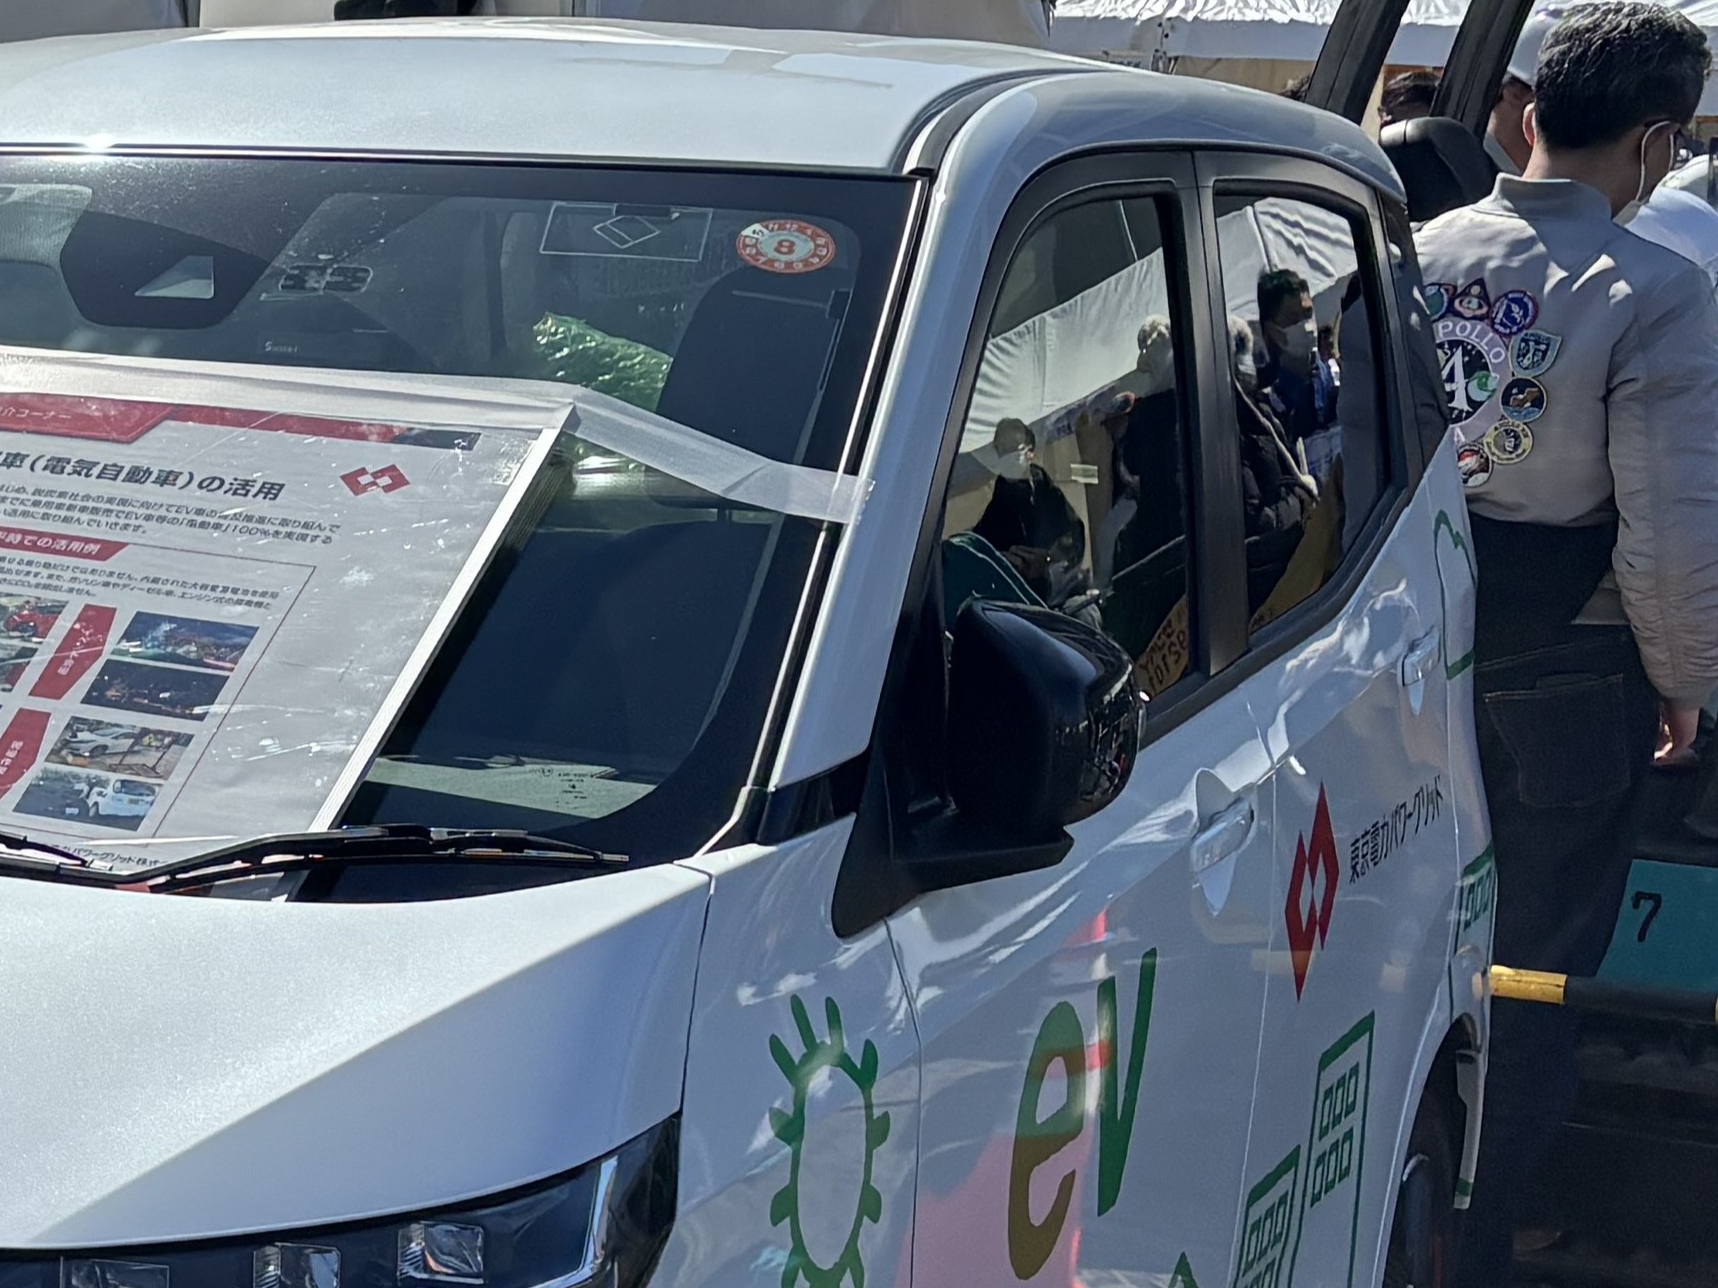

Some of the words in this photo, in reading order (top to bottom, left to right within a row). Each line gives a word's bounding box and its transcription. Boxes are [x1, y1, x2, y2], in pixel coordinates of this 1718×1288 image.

[1437, 321, 1505, 363] POLLO
[1349, 775, 1444, 884] 東京電力パワーグリッド
[1631, 890, 1663, 943] 7
